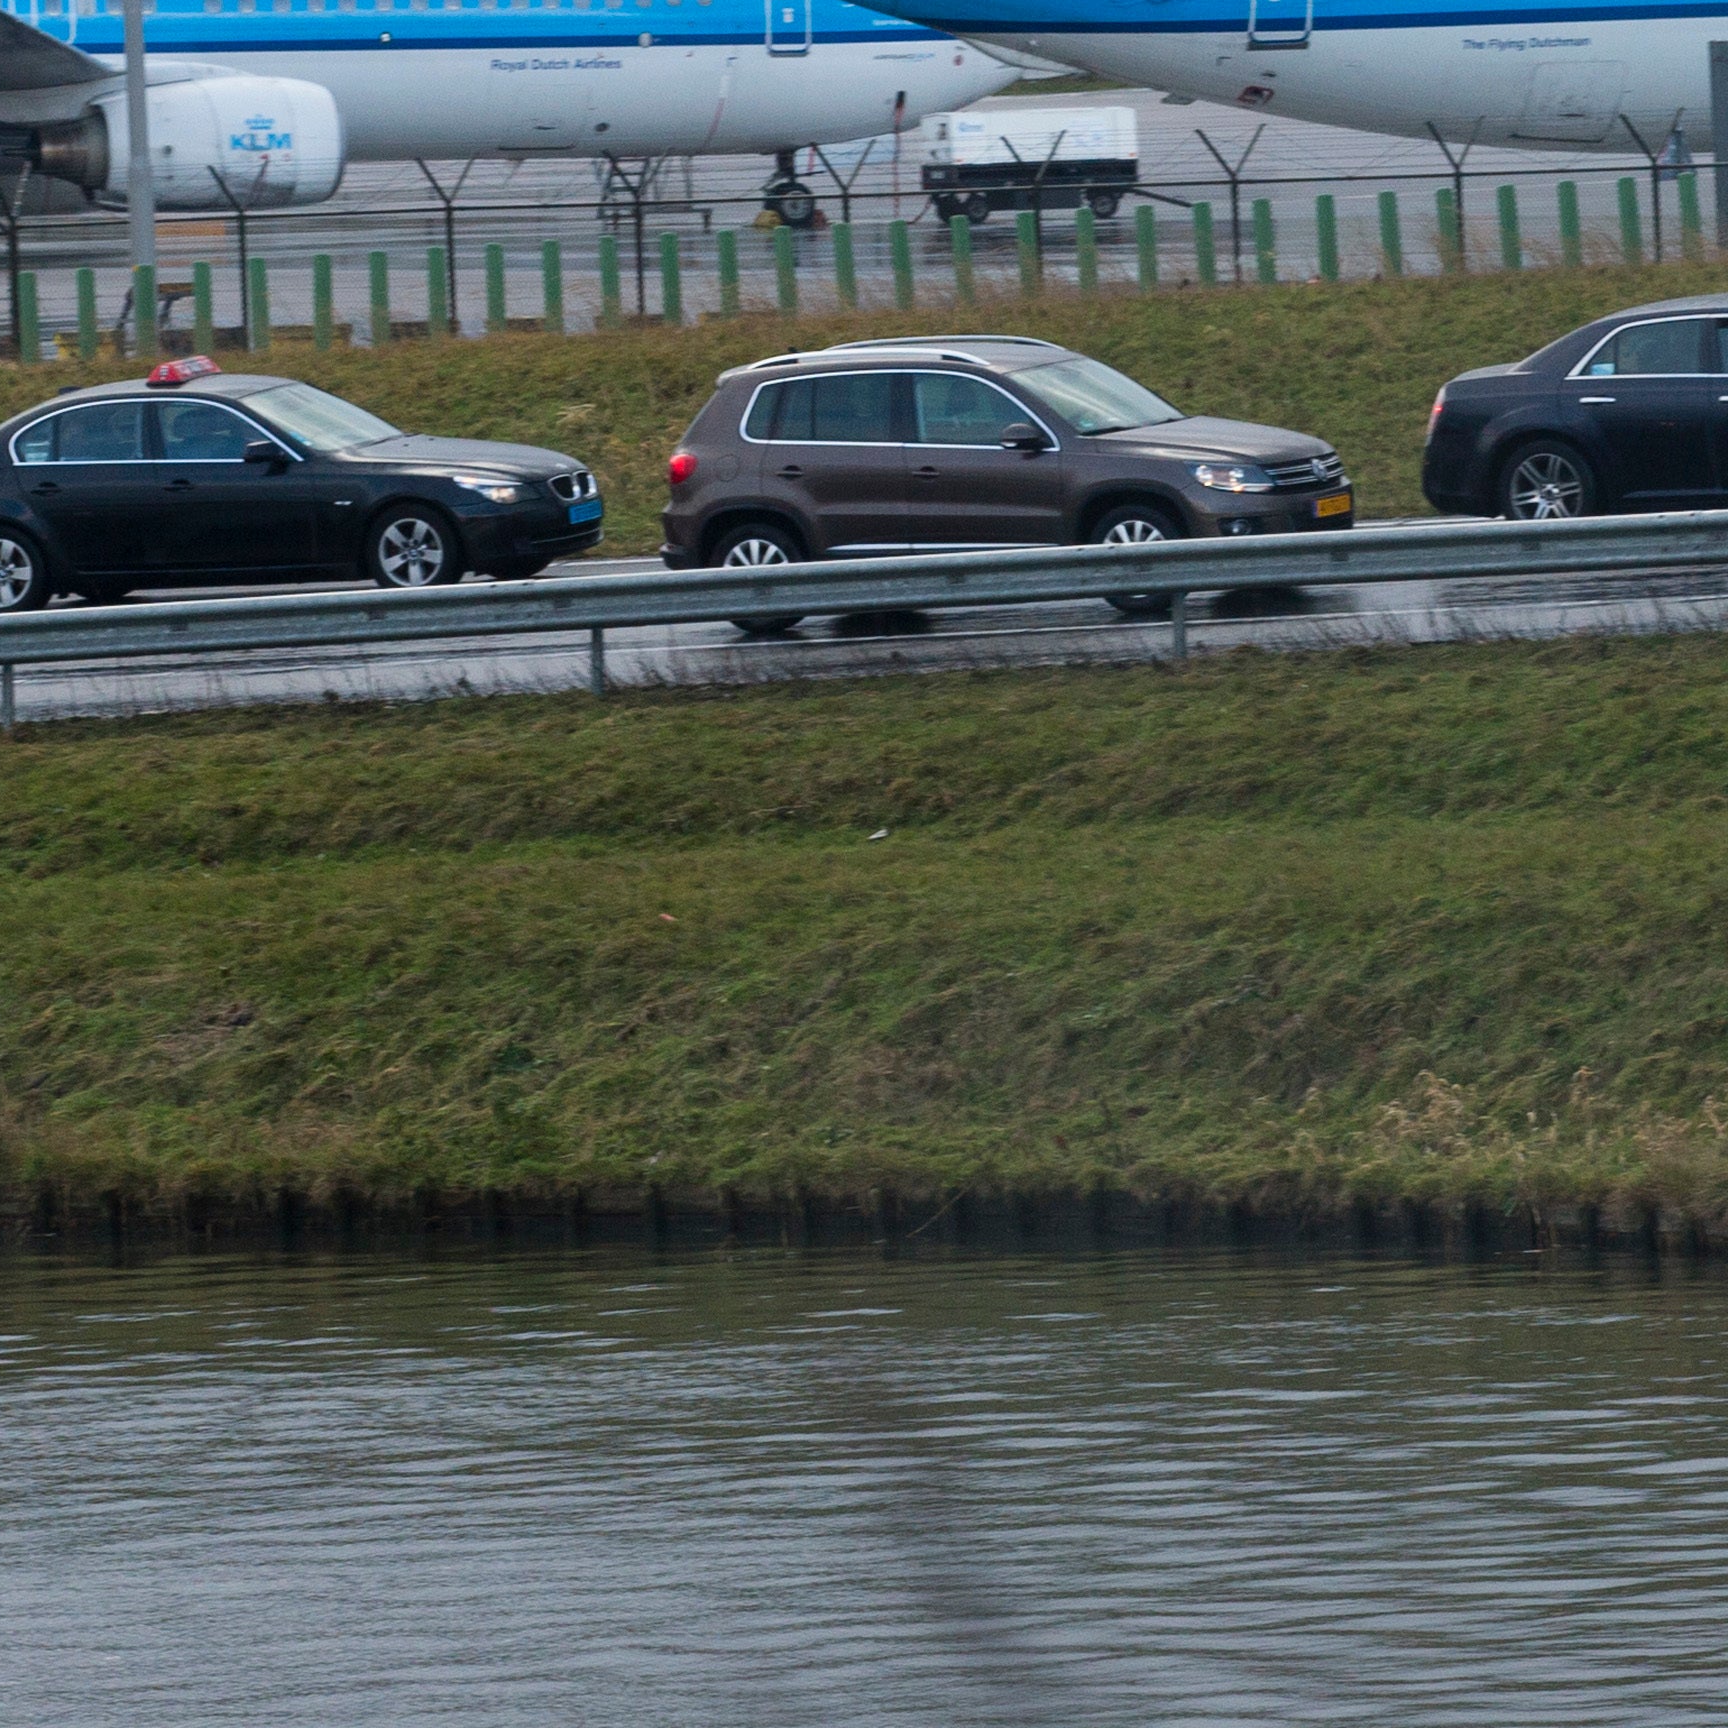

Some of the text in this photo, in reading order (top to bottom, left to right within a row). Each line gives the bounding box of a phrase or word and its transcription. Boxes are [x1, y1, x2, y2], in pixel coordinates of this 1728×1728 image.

[1487, 38, 1527, 52] Flying
[1529, 37, 1592, 48] Dutchman
[490, 58, 622, 72] Royal Dutch Airlines
[230, 133, 292, 151] KLM
